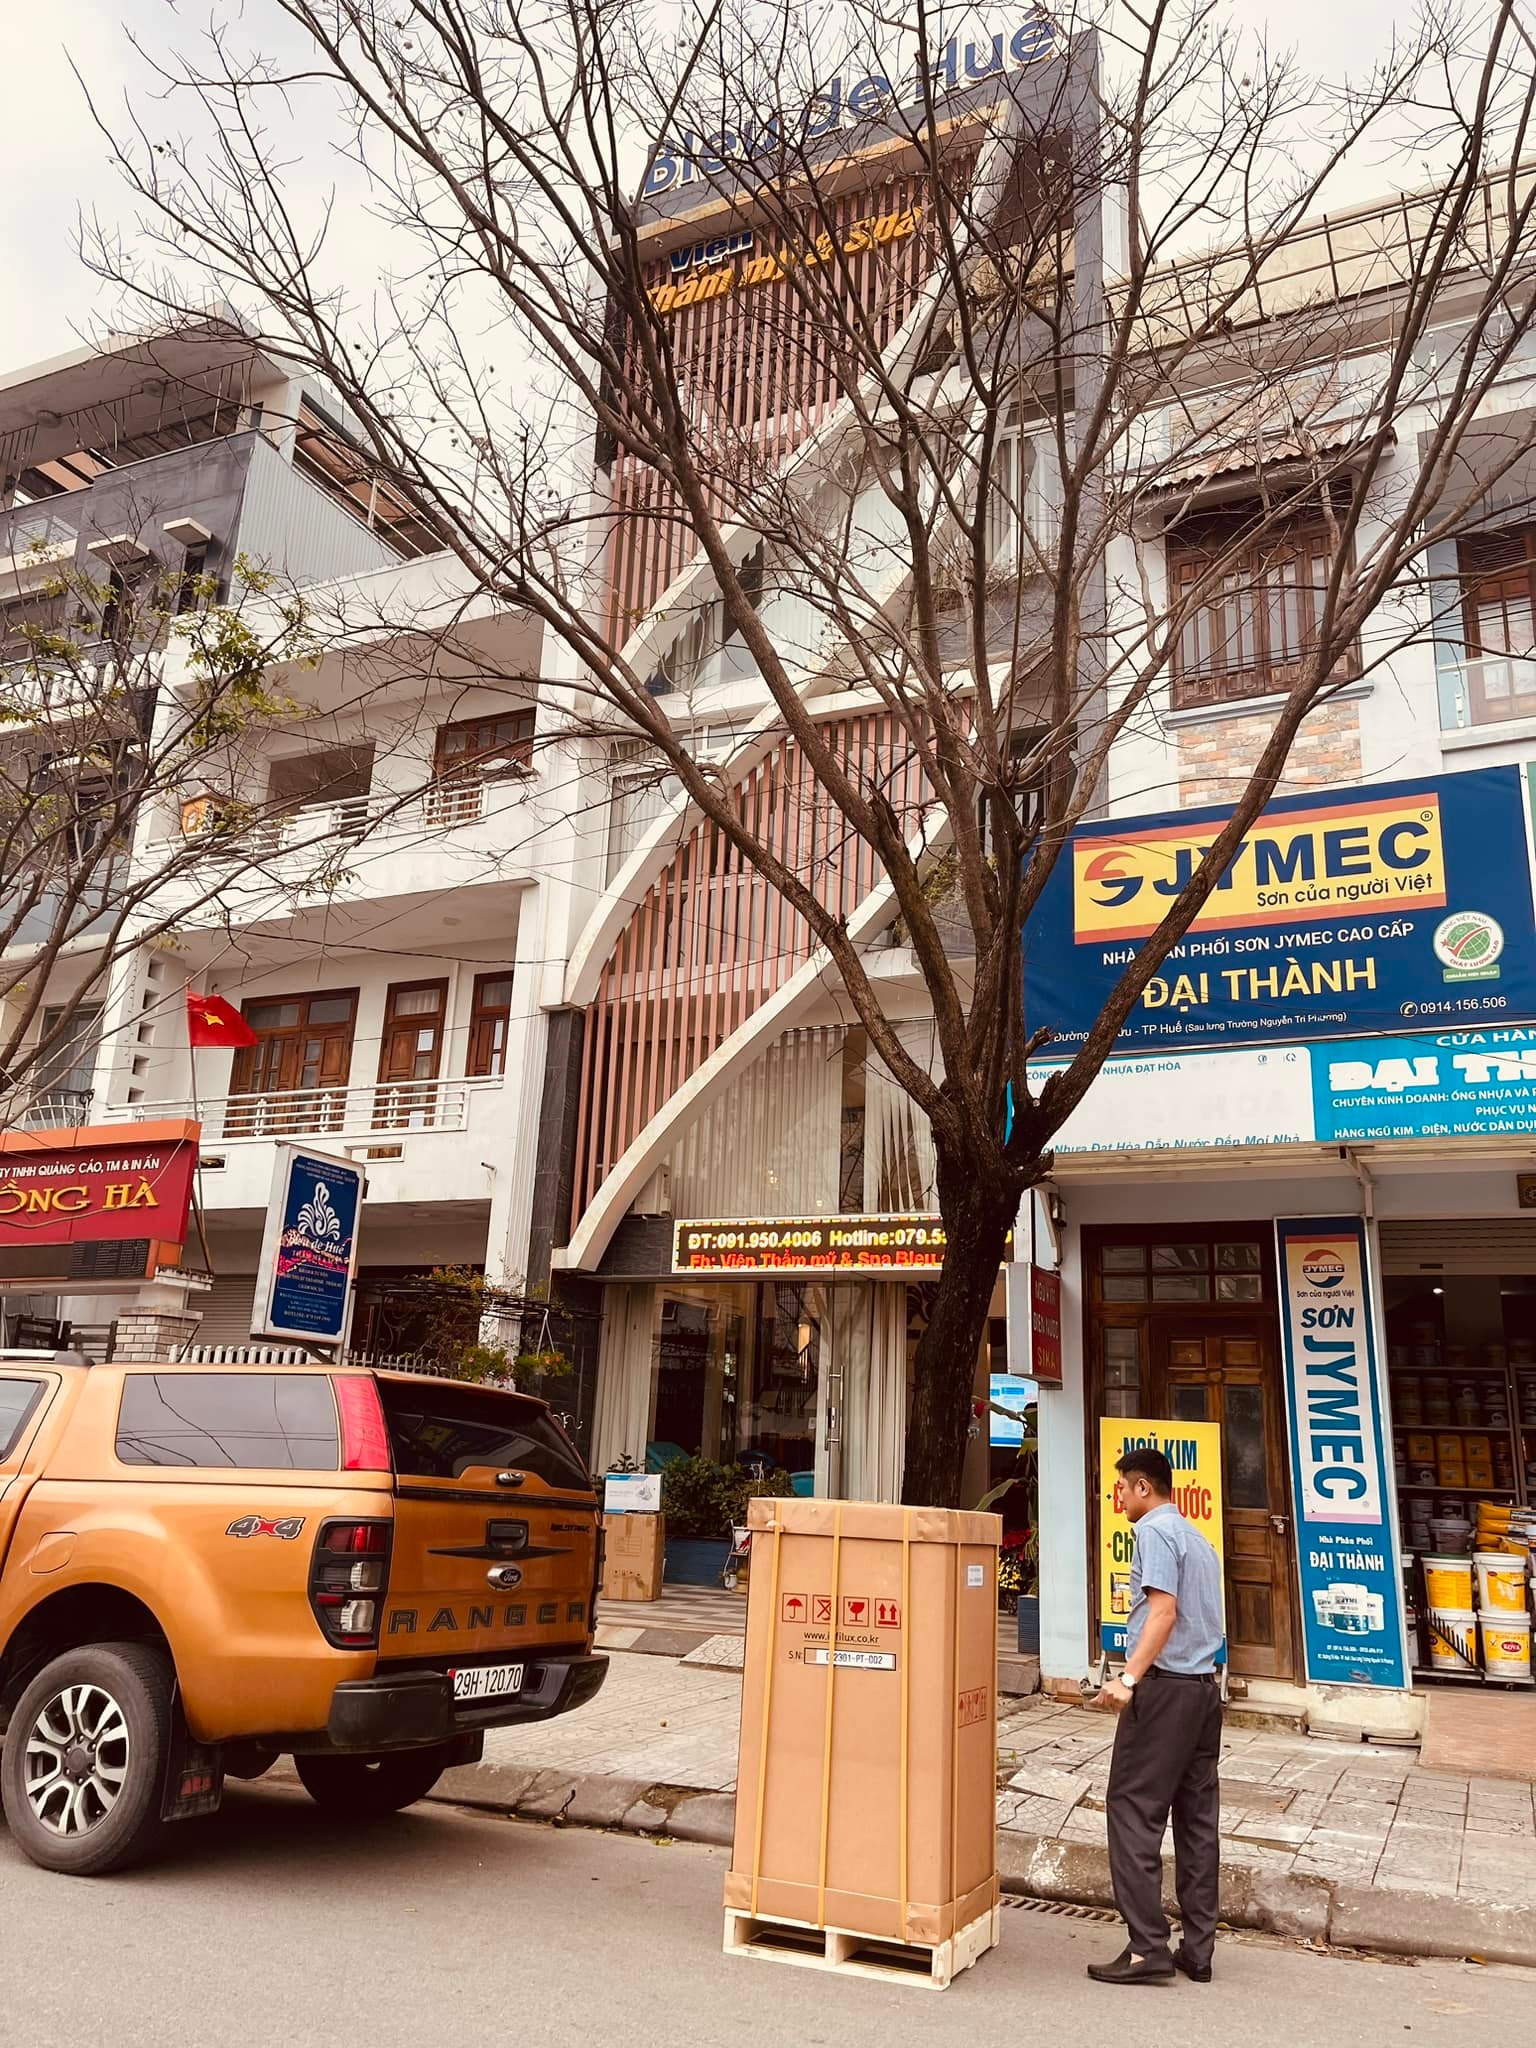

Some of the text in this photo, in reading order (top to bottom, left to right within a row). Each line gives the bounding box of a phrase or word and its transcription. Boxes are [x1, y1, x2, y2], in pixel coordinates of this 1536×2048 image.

[799, 75, 890, 139] de
[1153, 821, 1431, 895] JYMEC
[1256, 872, 1432, 907] Sơn của người Việt
[1103, 947, 1136, 965] NHÀ
[1190, 937, 1229, 957] PHỐI
[1234, 937, 1270, 952] SƠN
[1274, 930, 1333, 949] JYMEC
[1337, 926, 1373, 941] CAO
[1377, 919, 1414, 938] CẤP
[1141, 957, 1377, 1012] ĐẠI THÀNH
[1420, 996, 1507, 1014] 0914.156.506
[1141, 1024, 1157, 1035] TP
[1160, 1020, 1182, 1034] Huế
[1185, 1022, 1204, 1033] (Sau
[1206, 1022, 1225, 1031] lưng
[1226, 1019, 1258, 1029] Trường
[1436, 1031, 1487, 1046] CỬA
[1328, 1056, 1440, 1093] ĐẠI
[1332, 1095, 1375, 1107] CHUYÊN
[1377, 1095, 1403, 1105] KINH
[1406, 1093, 1449, 1104] DOANH:
[1478, 1088, 1513, 1100] NHỰA
[1514, 1086, 1530, 1097] VÀ
[1475, 1105, 1507, 1117] PHỤC
[1508, 1104, 1525, 1116] VỤ
[1334, 1127, 1365, 1138] HÀNG
[1393, 1125, 1413, 1135] KIM
[1422, 1123, 1451, 1135] ĐIỆN,
[1453, 1120, 1487, 1132] NƯỚC
[12, 1166, 37, 1177] TNHH
[38, 1161, 75, 1176] QUẢNG
[78, 1158, 104, 1174] CÁO,
[106, 1160, 120, 1171] TM
[121, 1159, 129, 1171] &
[130, 1159, 143, 1170] IN
[143, 1153, 160, 1169] ẤN
[102, 1176, 160, 1209] HÀ
[688, 1228, 947, 1249] ĐT:091.950.4006 Hotline:079.5
[841, 1251, 853, 1266] &
[895, 1250, 936, 1265] Bleu
[1300, 1304, 1355, 1328] SƠN
[1303, 1335, 1367, 1500] JYMEC
[1164, 1440, 1197, 1470] KIM
[1319, 1535, 1333, 1544] Nhà
[1335, 1536, 1355, 1545] Phân
[1309, 1549, 1385, 1571] ĐẠI THÀNH
[503, 1570, 519, 1582] Ford
[388, 1602, 585, 1634] RANGER
[804, 1631, 879, 1644] www.ifilux.co.kr
[826, 1652, 883, 1664] 2301-PT-002
